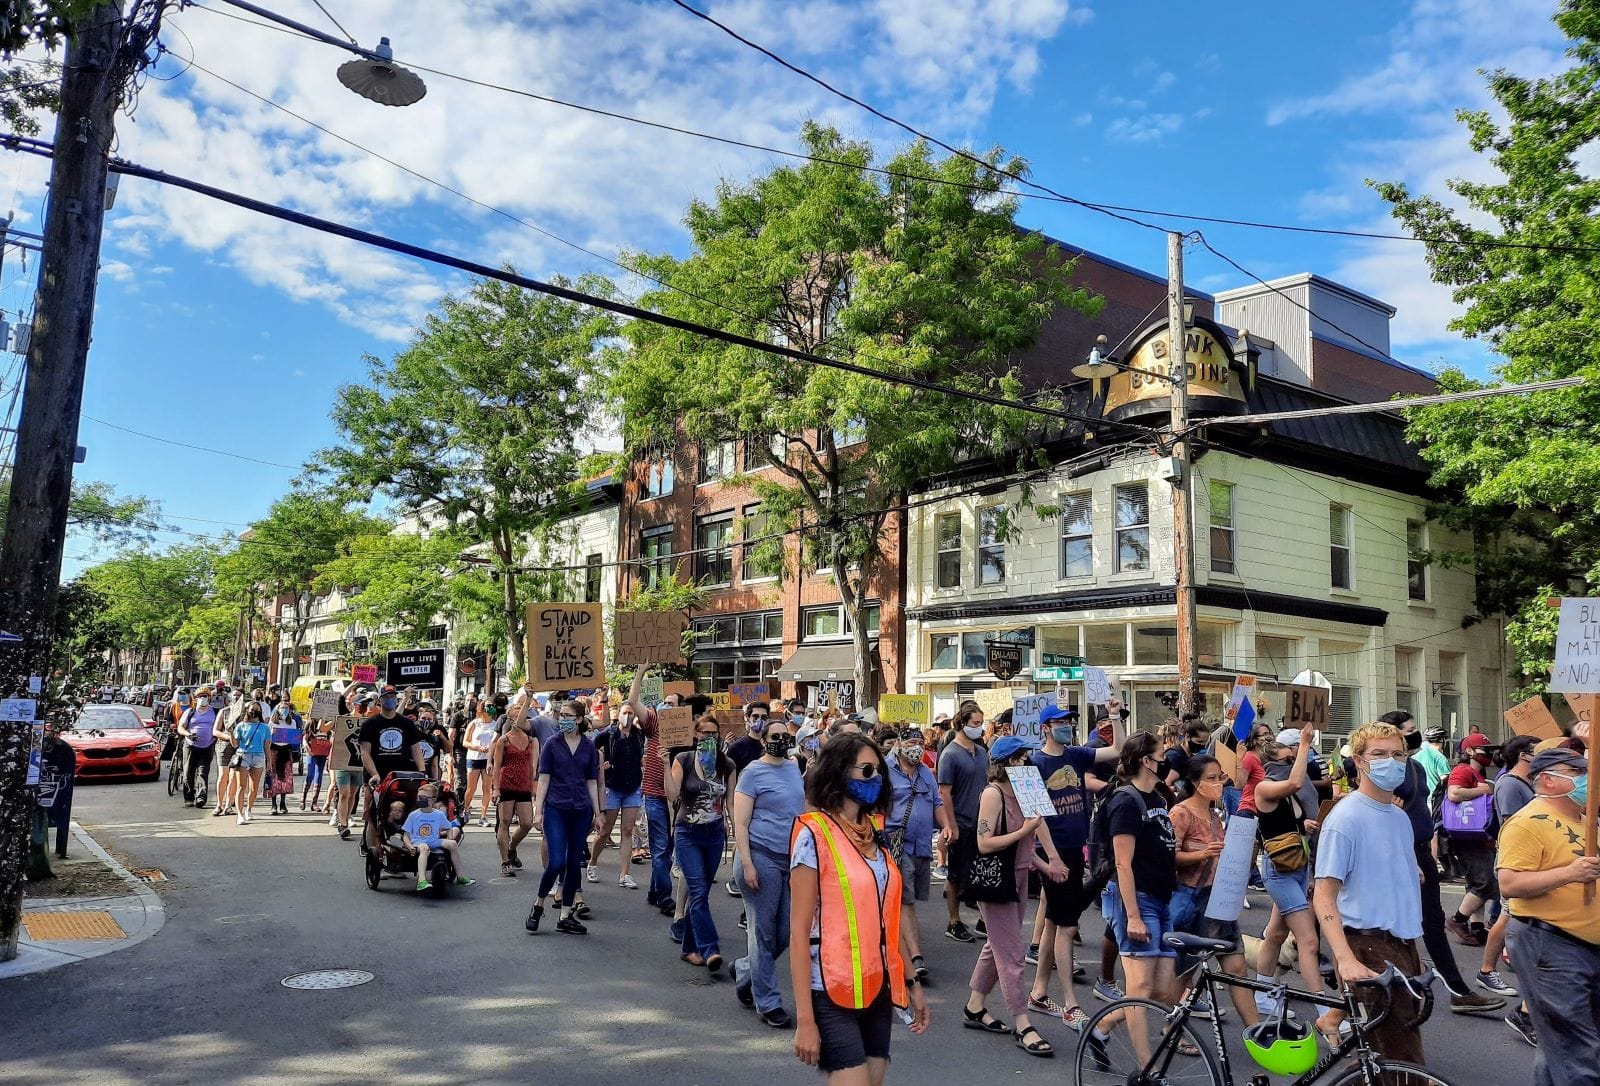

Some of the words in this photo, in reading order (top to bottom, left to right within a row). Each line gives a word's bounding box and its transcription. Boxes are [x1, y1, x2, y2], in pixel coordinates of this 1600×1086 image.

[1152, 333, 1214, 359] BNK
[1132, 362, 1230, 389] BUIDING
[541, 609, 592, 628] STAND
[619, 611, 680, 630] BLACK
[555, 626, 575, 638] UP
[620, 629, 679, 646] LIVES
[556, 638, 573, 646] FOR
[393, 656, 415, 664] BLACK
[545, 645, 591, 660] BLACK
[617, 645, 676, 662] MATTER
[991, 650, 1019, 660] BALLARD
[1053, 654, 1072, 665] Vernon
[544, 661, 594, 681] LIVES
[1035, 669, 1058, 679] Ballard
[1074, 670, 1084, 678] NW
[1567, 662, 1590, 685] NO
[733, 684, 769, 694] DEFUND
[819, 680, 853, 696] DEFUND
[818, 693, 829, 706] SP
[909, 699, 924, 714] SPD
[1290, 690, 1325, 724] BLM
[345, 719, 362, 729] BL
[1013, 720, 1044, 740] VOIC
[1011, 779, 1046, 795] TRANS
[1020, 791, 1052, 805] LIVES
[1058, 802, 1084, 815] UTTLE?
[1206, 990, 1226, 1062] SCHWINN
